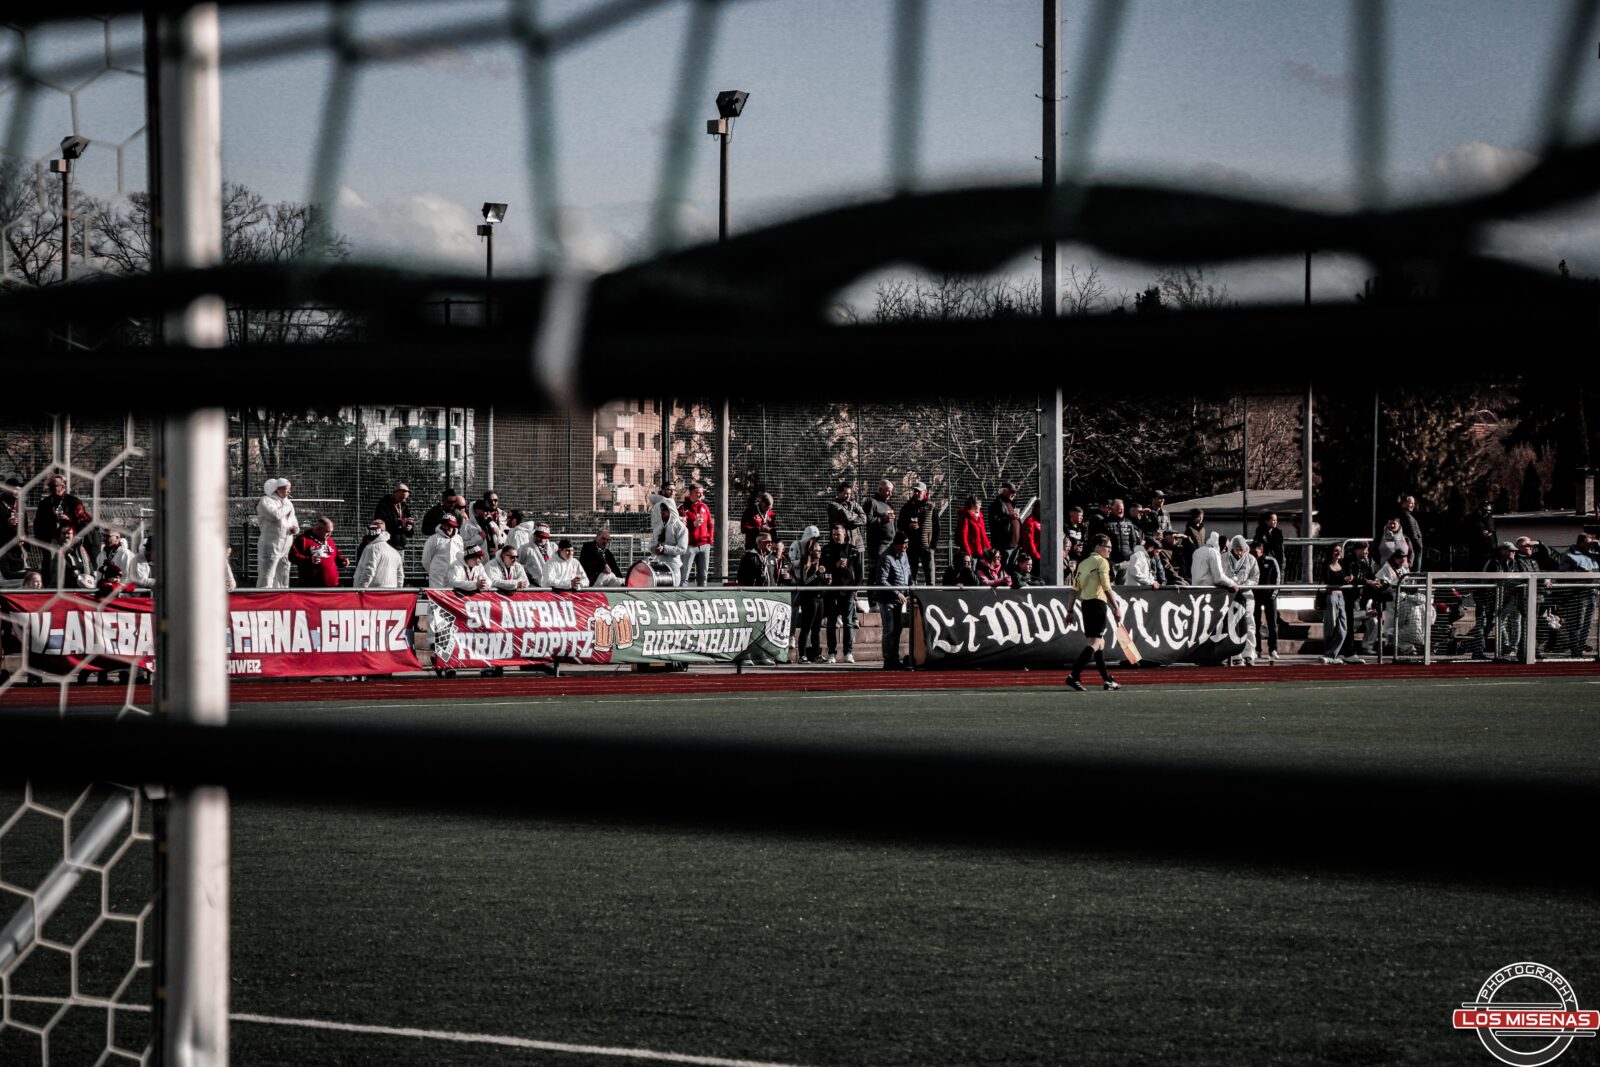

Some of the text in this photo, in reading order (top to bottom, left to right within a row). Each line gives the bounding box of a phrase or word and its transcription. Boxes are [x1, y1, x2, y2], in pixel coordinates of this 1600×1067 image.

[464, 600, 577, 629] SV AUFBAU
[651, 598, 740, 625] LIMBACH
[742, 597, 770, 623] 90
[62, 610, 156, 656] AUFBA
[230, 610, 313, 653] PIRNA
[320, 609, 408, 653] COPITZ
[455, 632, 514, 661] PIRNA
[520, 631, 594, 659] COPITZ
[642, 628, 753, 656] BIRKENHAIN
